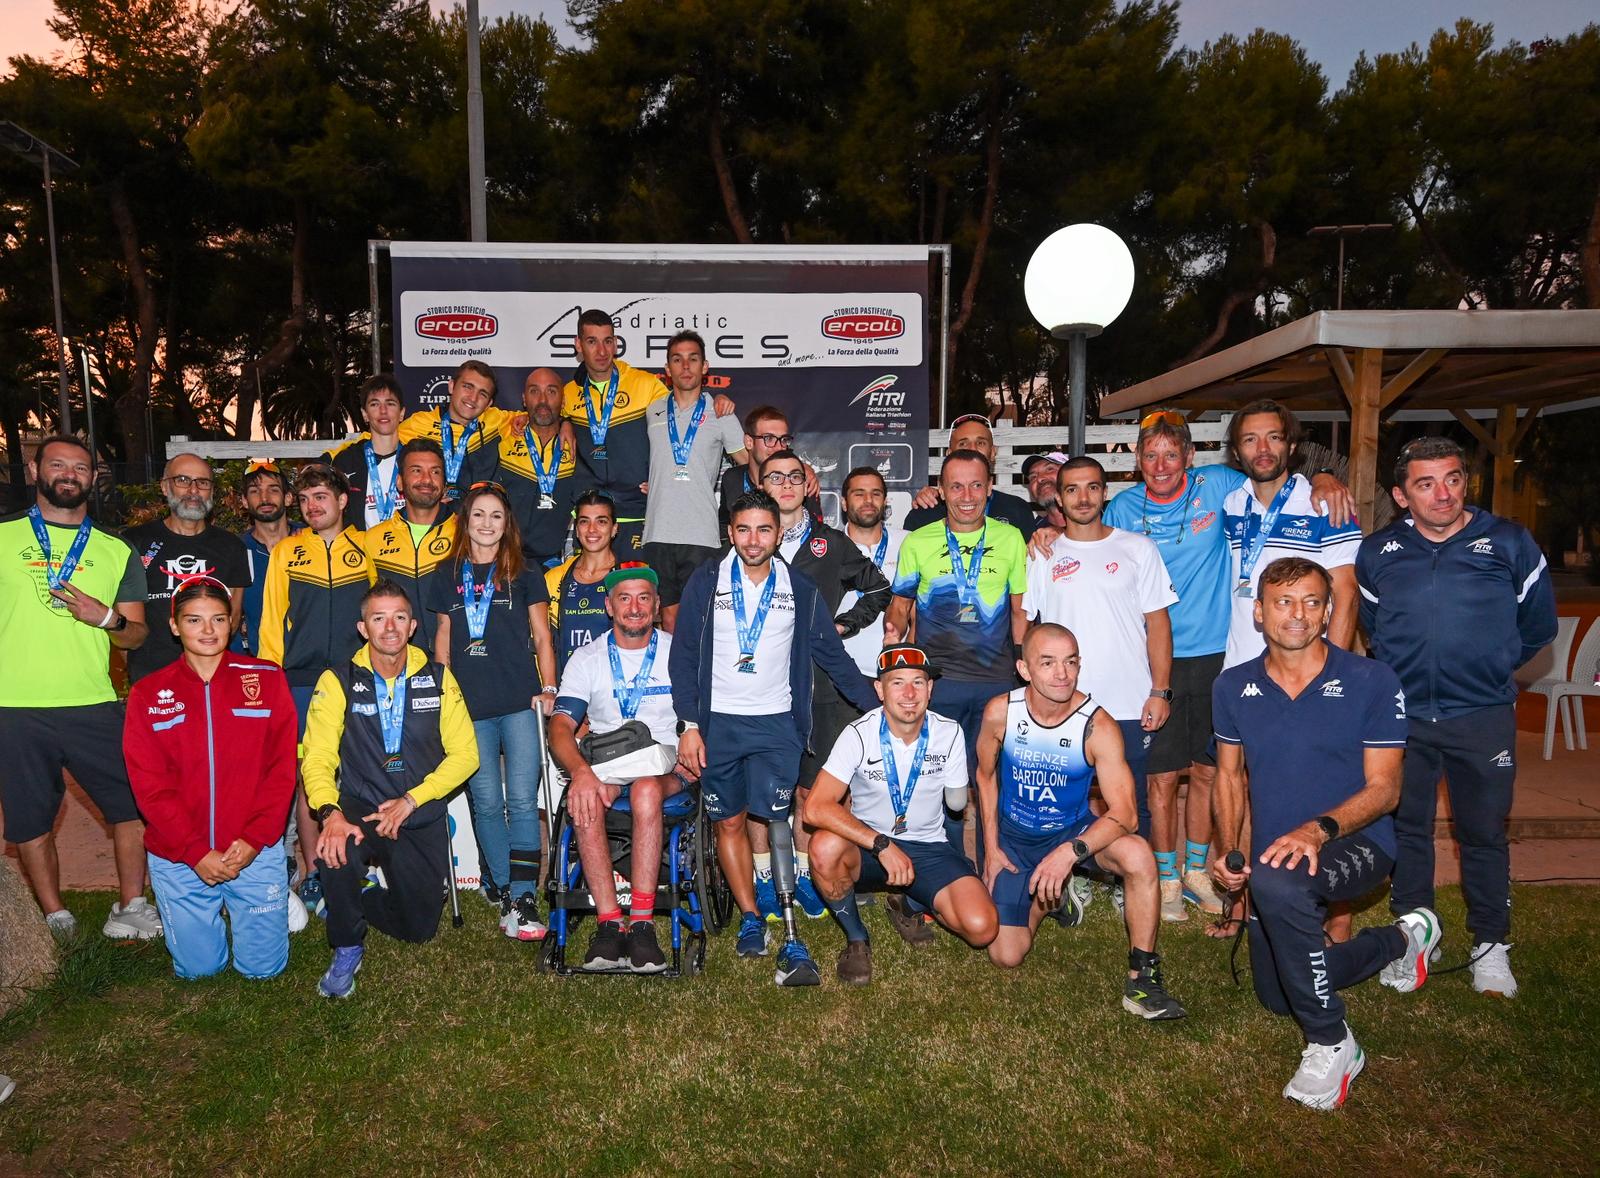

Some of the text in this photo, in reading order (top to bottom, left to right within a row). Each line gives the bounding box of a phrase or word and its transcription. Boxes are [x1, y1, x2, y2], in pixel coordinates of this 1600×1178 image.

[427, 306, 486, 315] STORICO PASTIFICIO
[834, 307, 893, 316] STORICO PASTIFICIO
[421, 319, 491, 332] ercoli
[613, 313, 728, 329] adriatic
[827, 319, 898, 332] ercoli
[422, 347, 492, 357] La Forza della Qualità
[828, 347, 899, 356] La Forza della Qualità
[868, 392, 906, 406] FITRI
[570, 629, 593, 647] ITA
[645, 687, 671, 695] TEAM
[148, 705, 176, 715] Allianz
[1012, 765, 1068, 787] BARTOLONI
[1018, 782, 1057, 802] ITA
